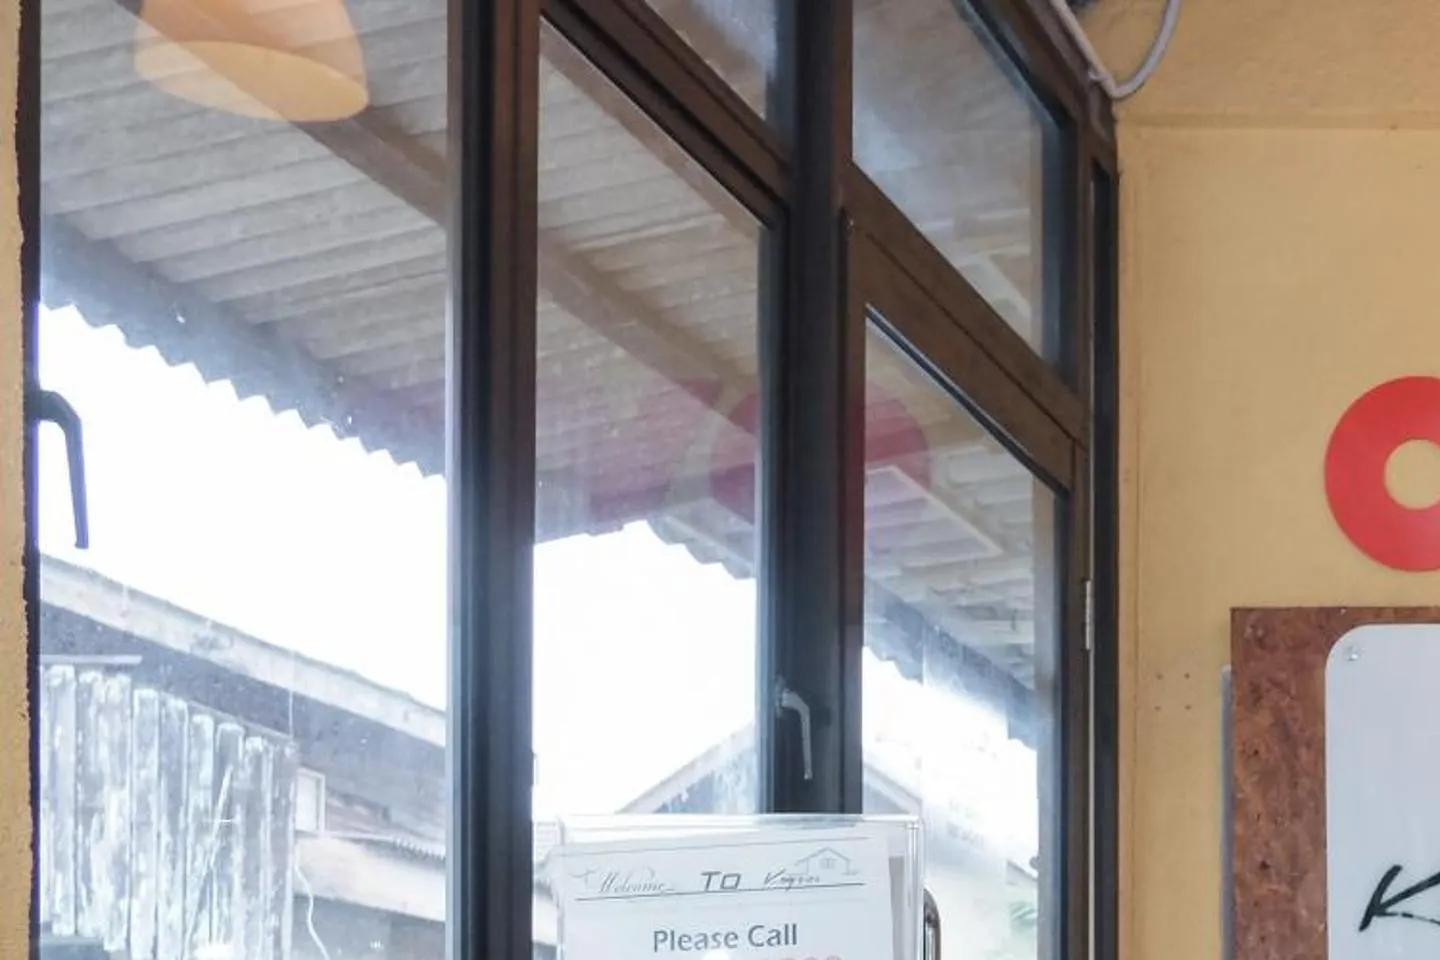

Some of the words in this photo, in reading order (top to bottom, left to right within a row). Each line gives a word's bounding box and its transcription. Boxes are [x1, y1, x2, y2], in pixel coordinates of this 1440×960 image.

[700, 870, 741, 893] TO
[653, 929, 739, 953] Please
[748, 924, 798, 947] Call
